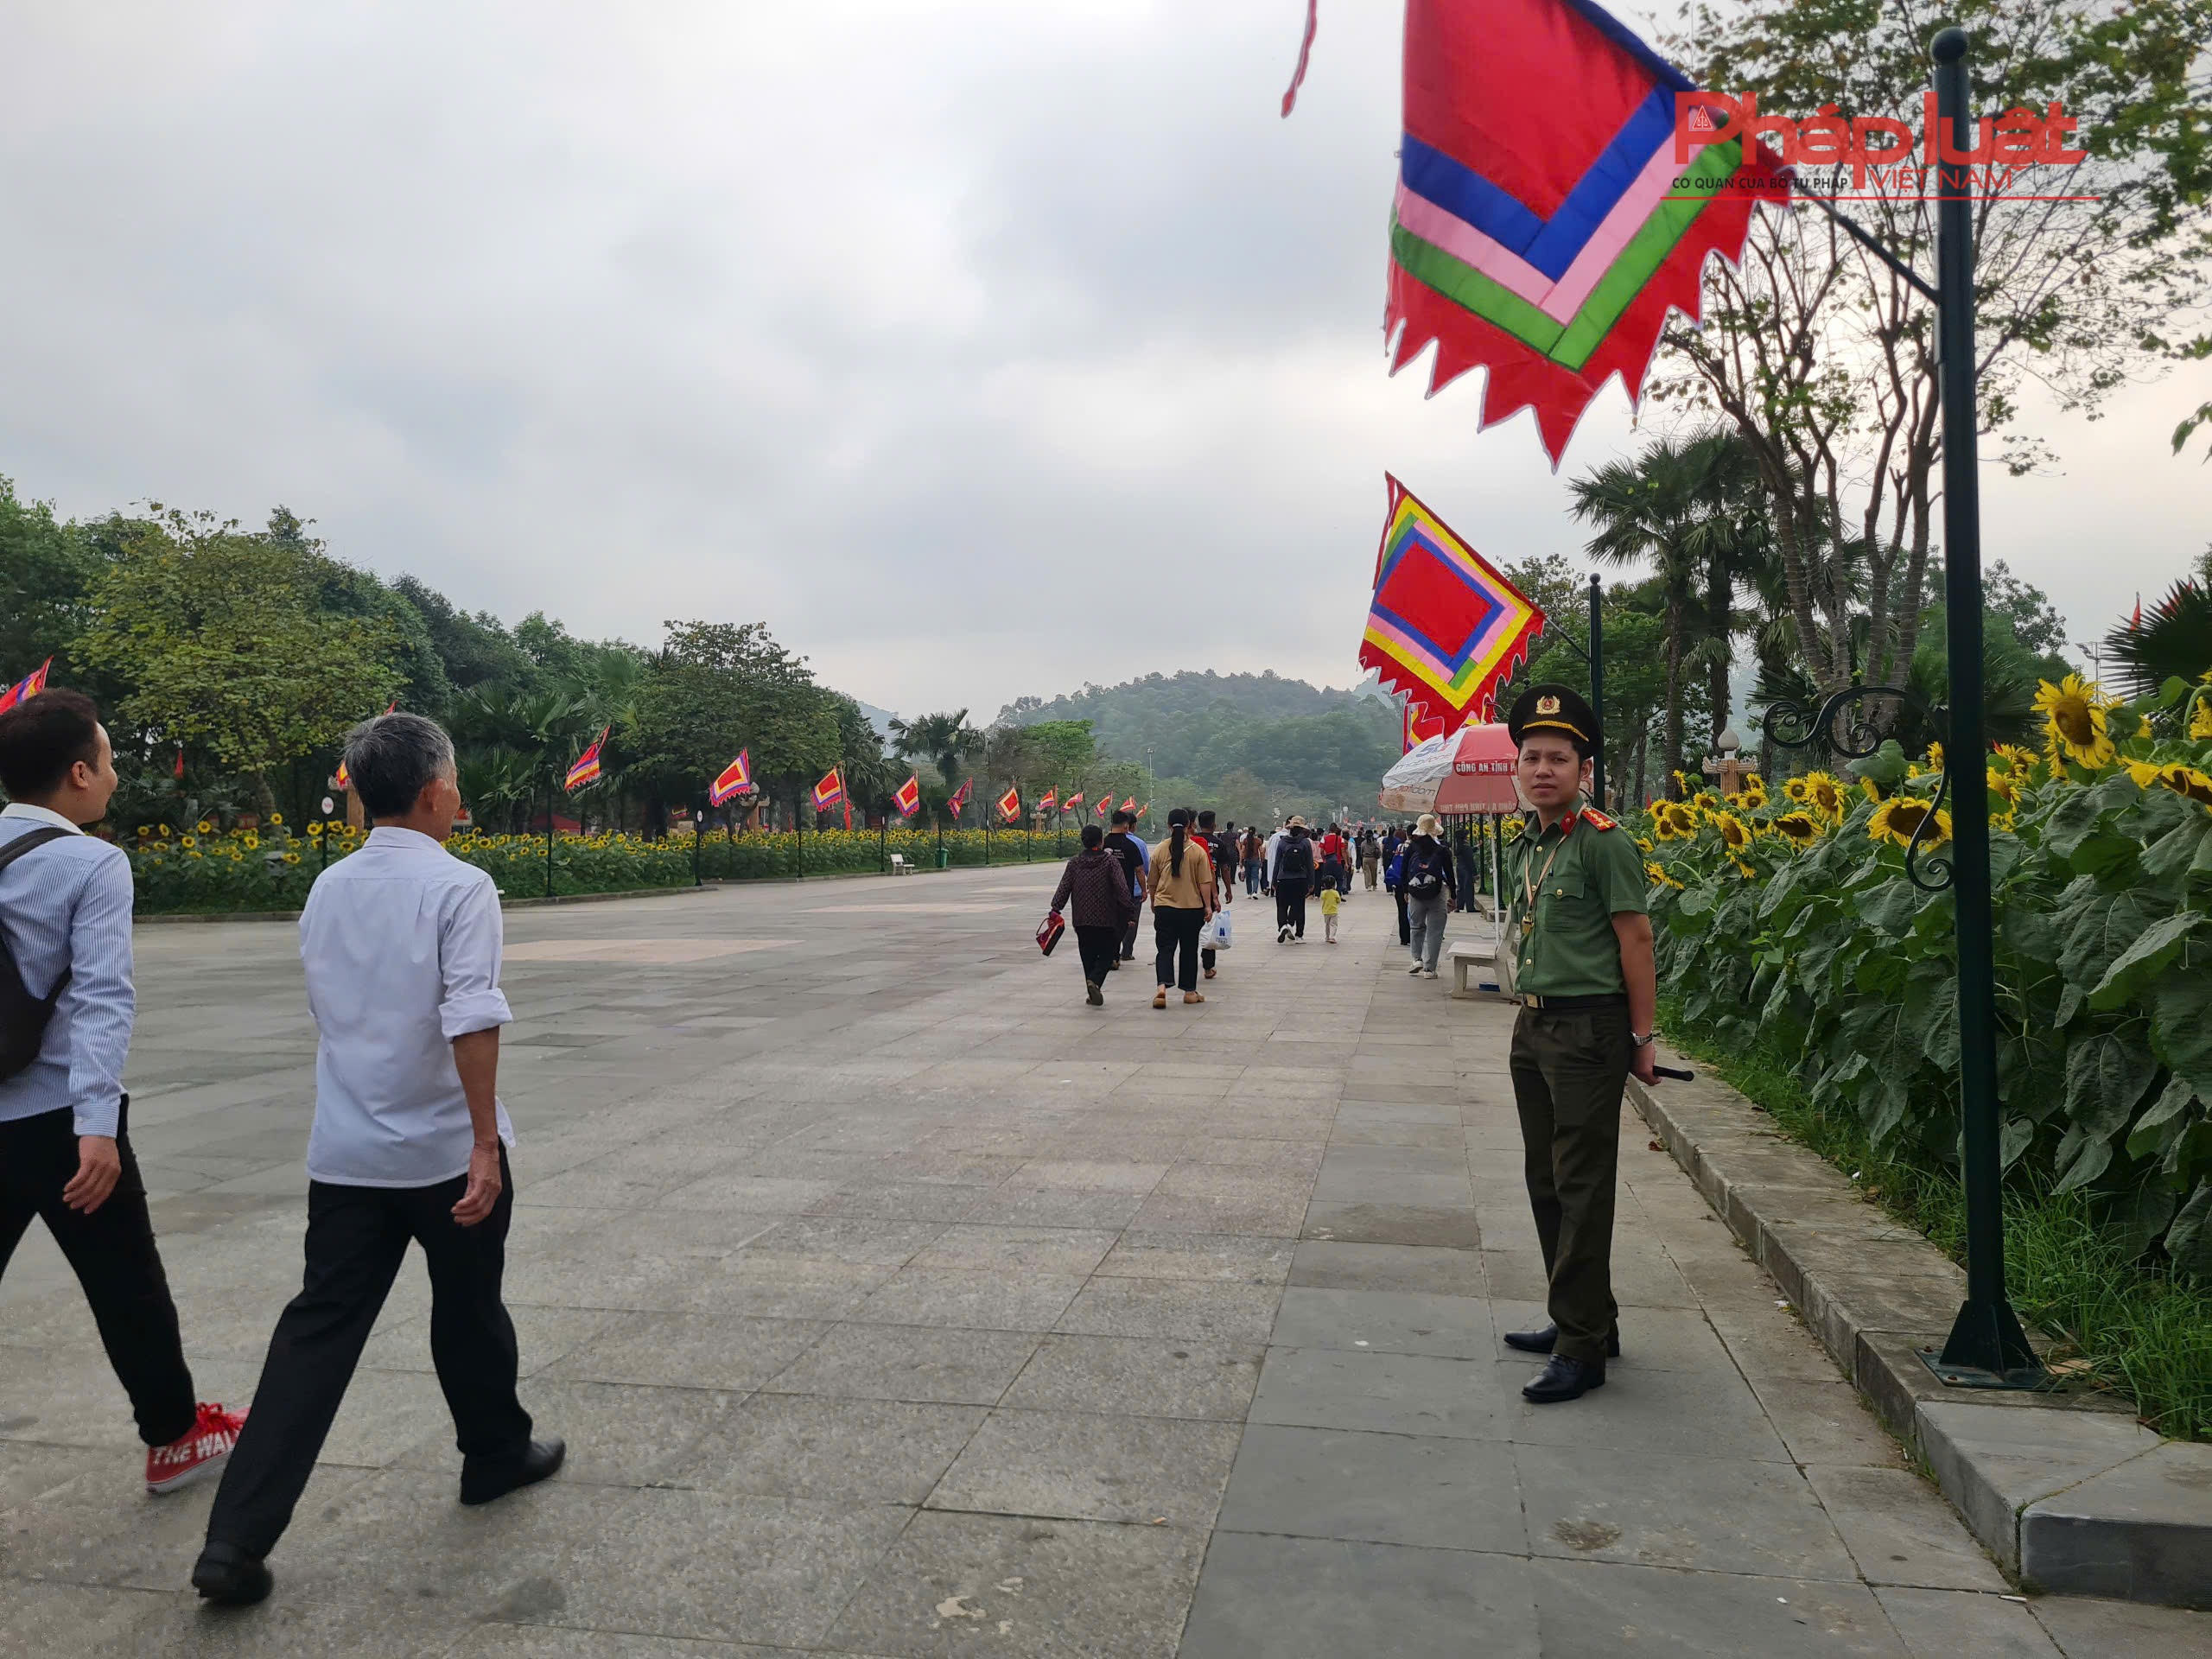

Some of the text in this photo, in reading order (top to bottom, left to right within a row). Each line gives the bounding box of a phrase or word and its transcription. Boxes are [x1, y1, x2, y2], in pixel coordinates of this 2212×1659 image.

[1456, 760, 1477, 772] CÔNG
[1478, 762, 1489, 772] AN
[153, 1440, 194, 1466] THE
